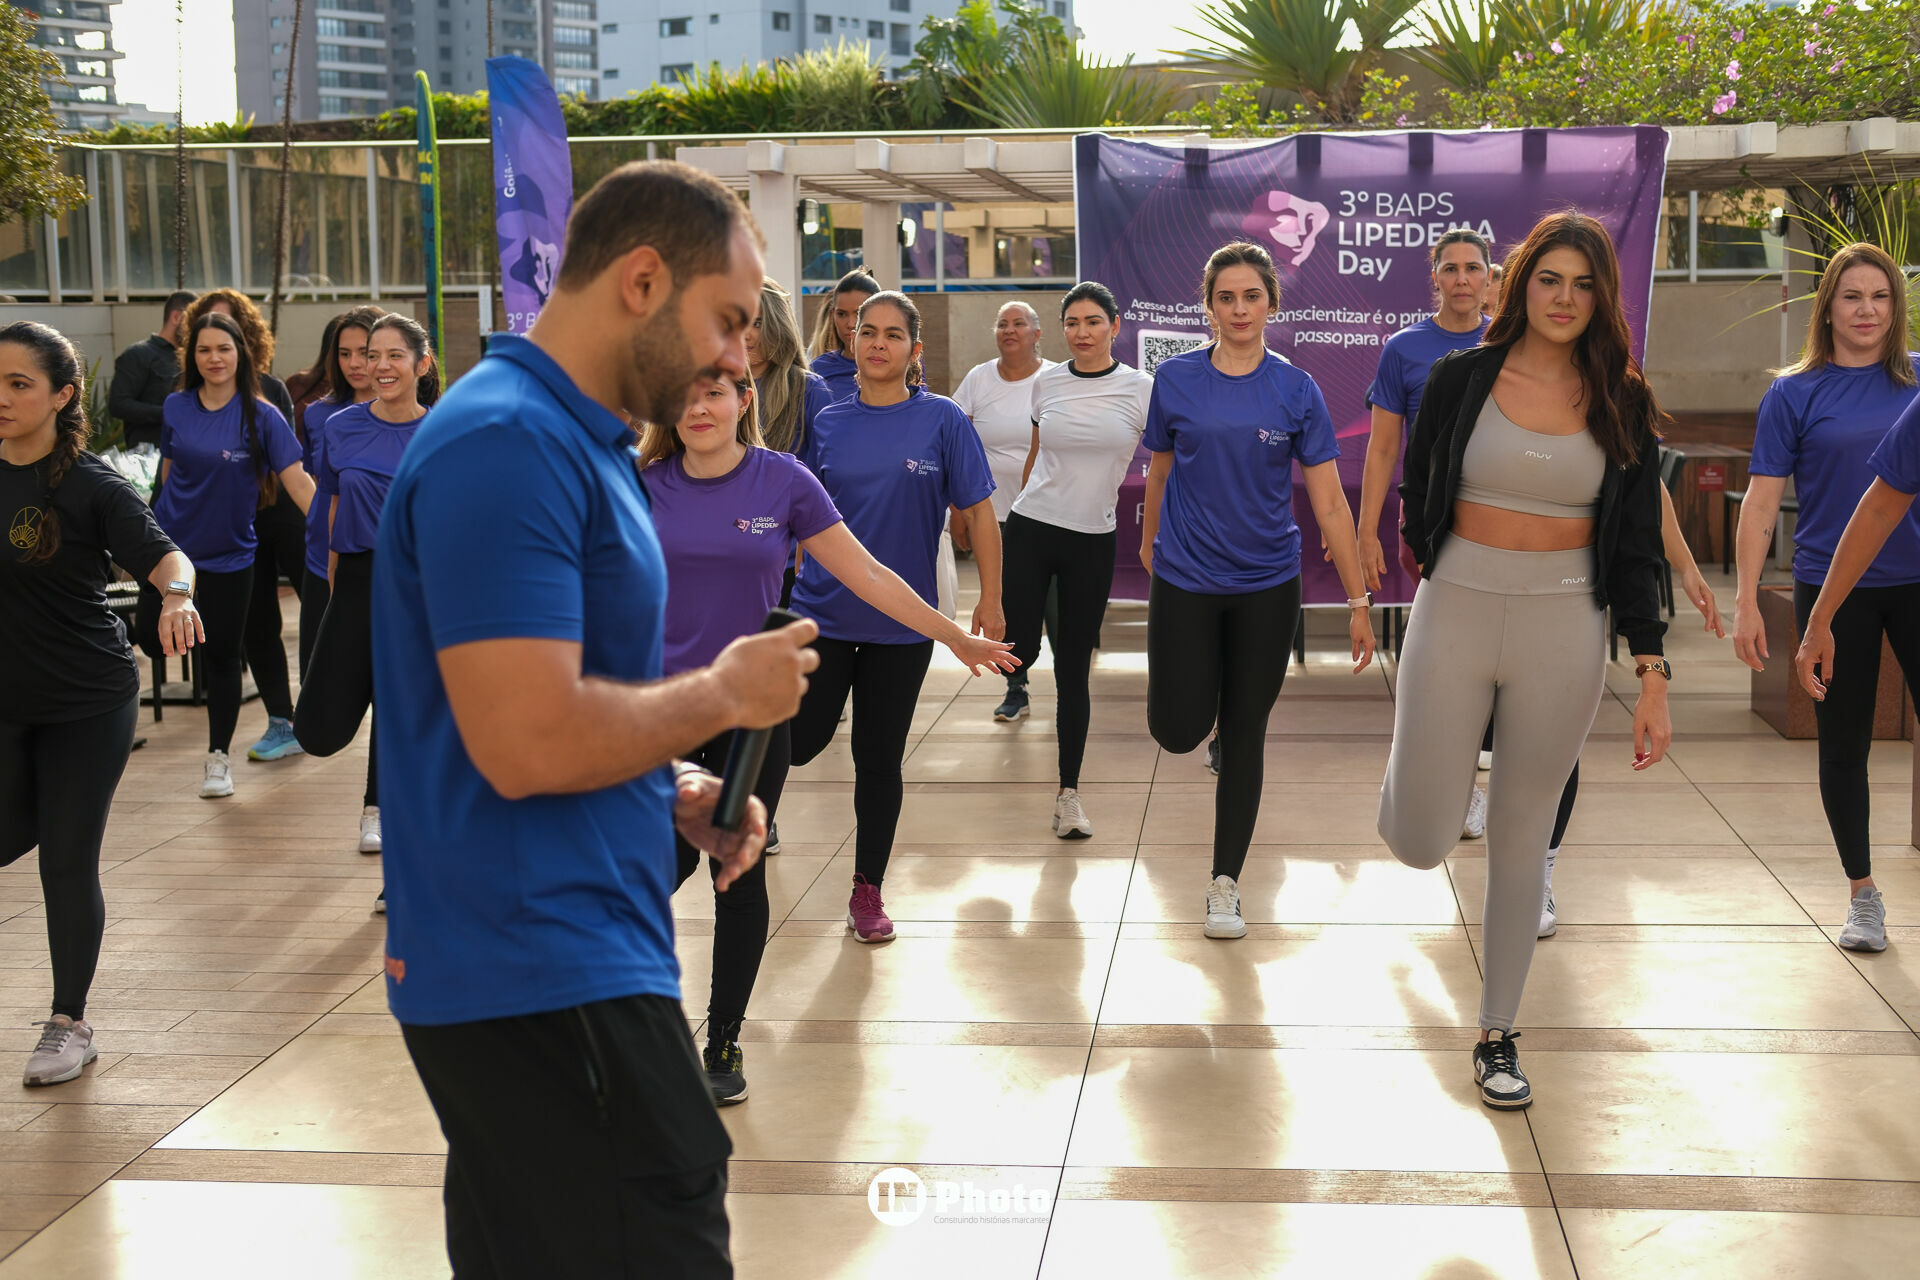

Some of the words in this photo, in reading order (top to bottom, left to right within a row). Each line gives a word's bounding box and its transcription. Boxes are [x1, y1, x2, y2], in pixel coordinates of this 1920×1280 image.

[1375, 192, 1454, 217] BAPS
[1338, 250, 1392, 282] Day
[1131, 298, 1166, 312] Acesse
[1167, 304, 1174, 313] a
[1124, 309, 1137, 321] do
[1150, 312, 1200, 326] Lipedema
[1372, 309, 1381, 324] é
[1385, 313, 1396, 325] o
[1294, 330, 1343, 347] passo
[1344, 332, 1379, 348] para
[1525, 450, 1552, 460] muv
[1561, 576, 1587, 584] muv
